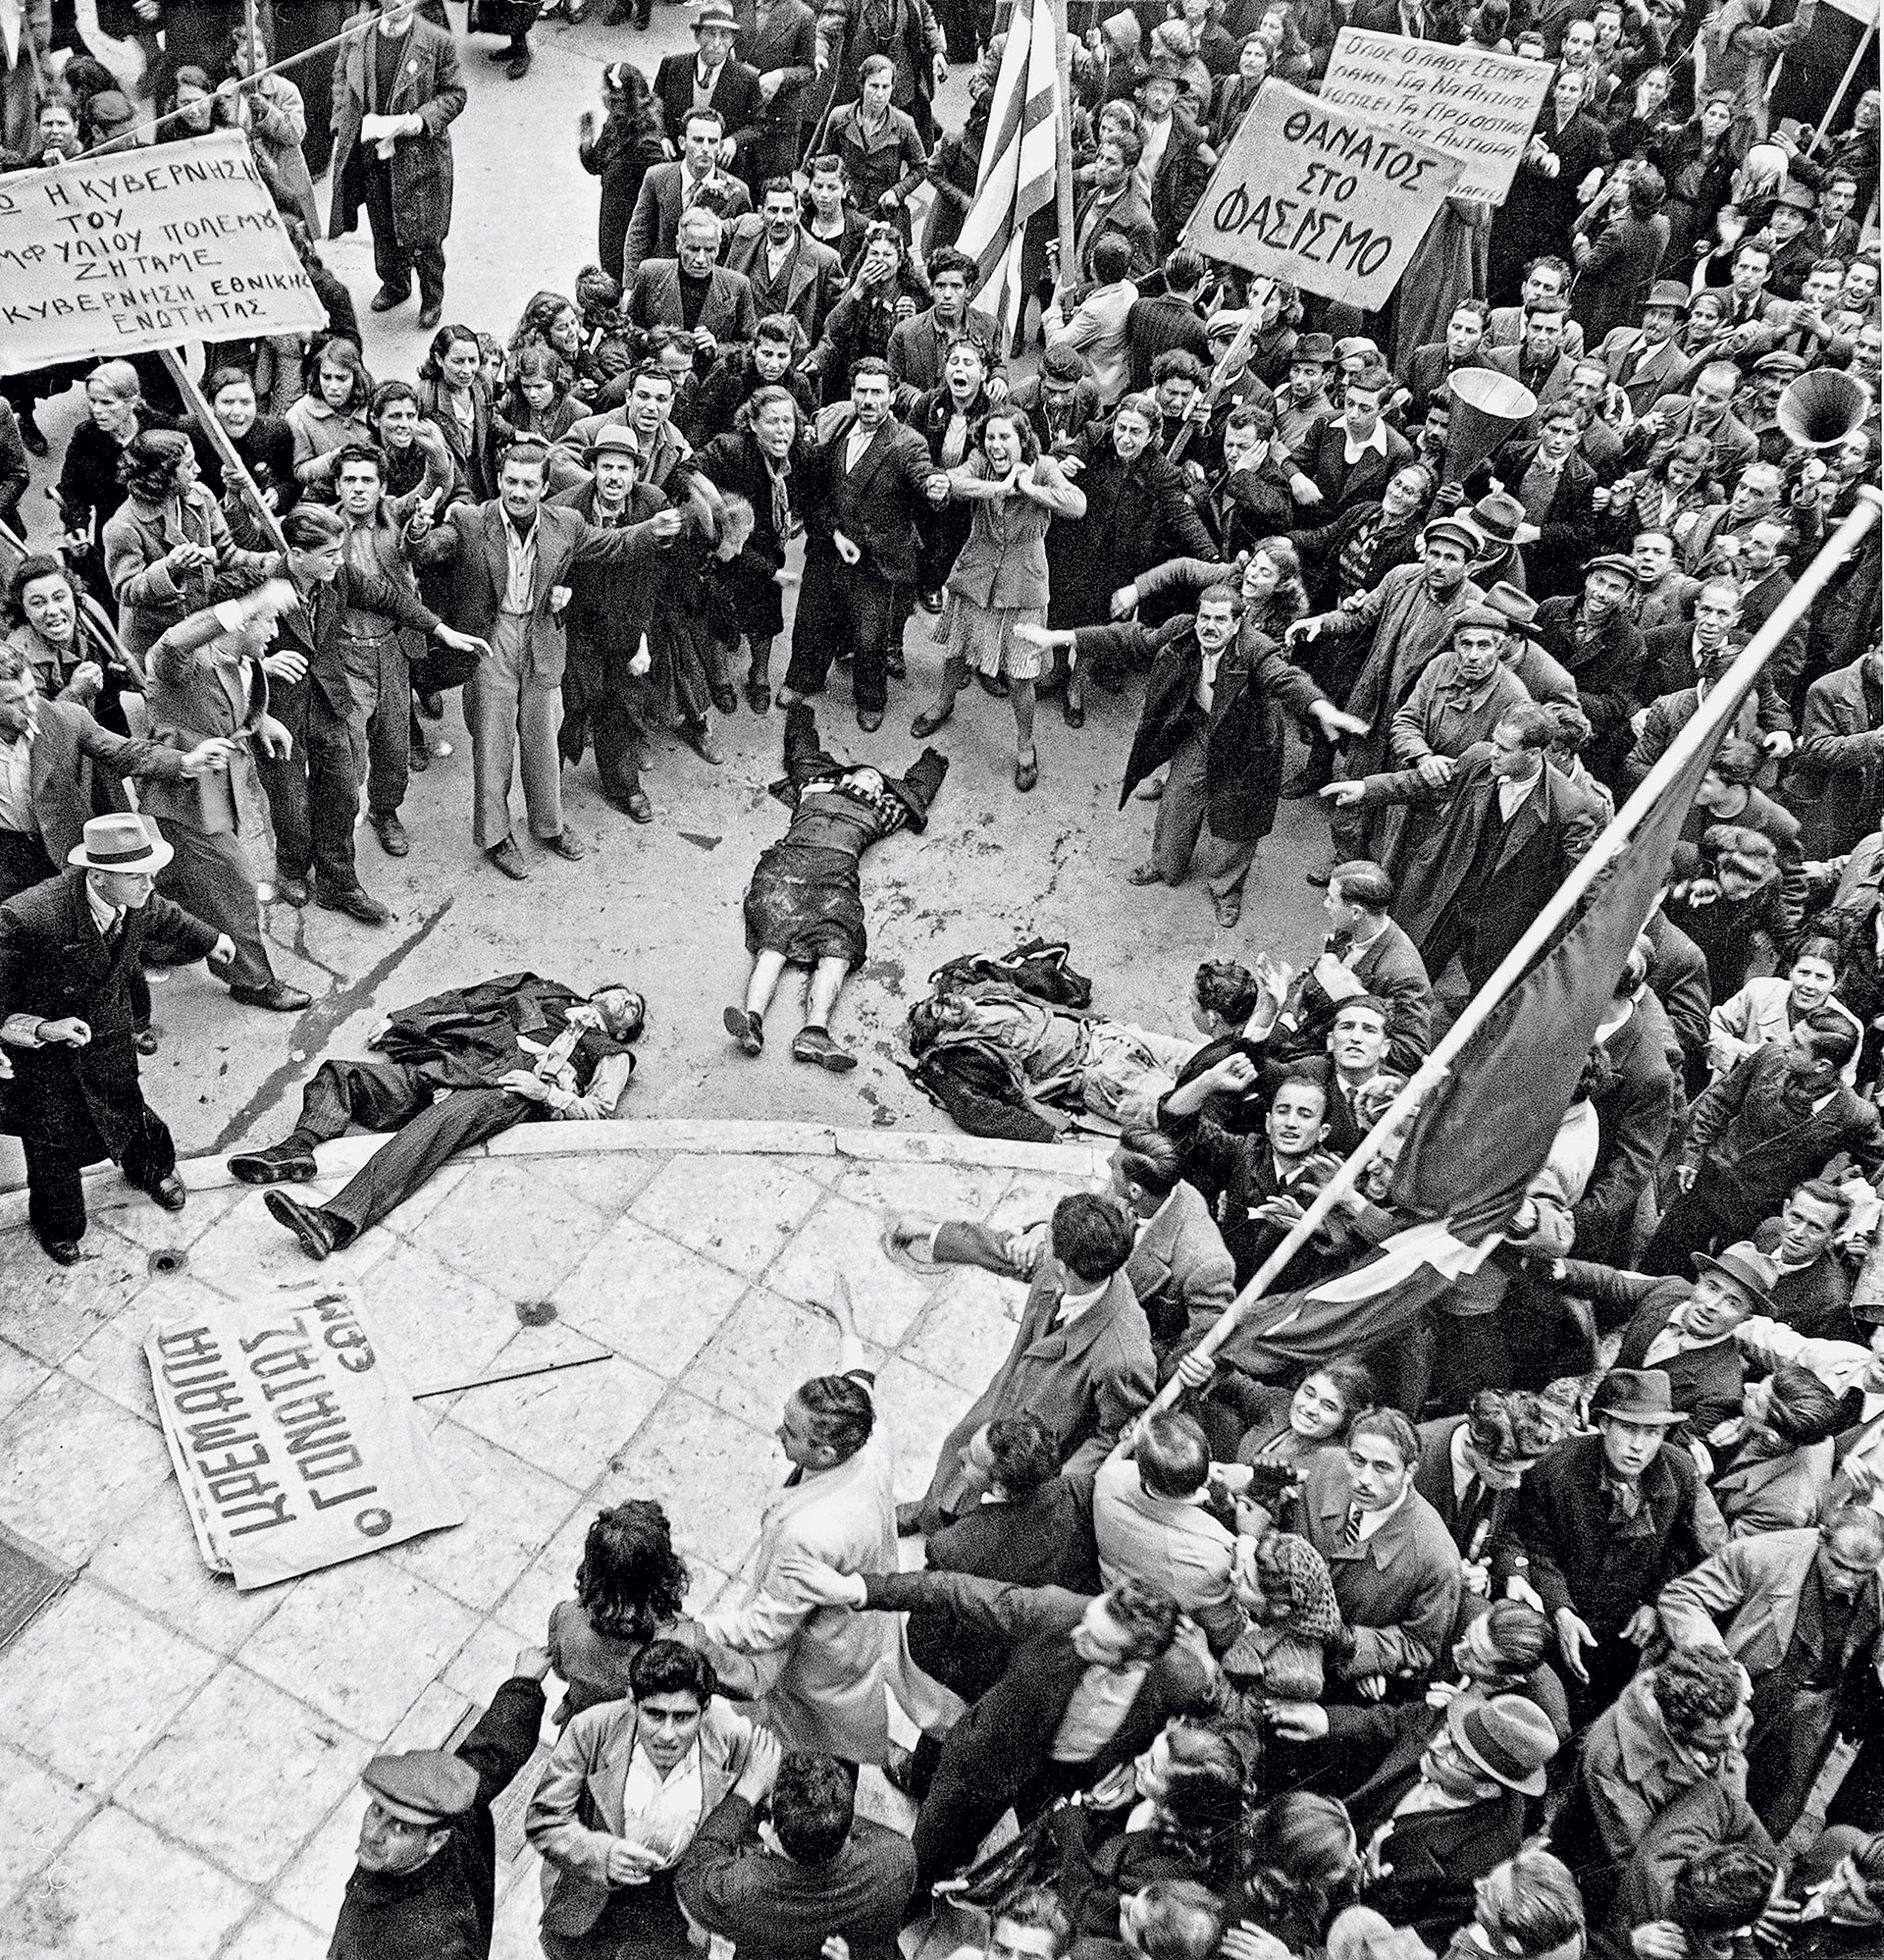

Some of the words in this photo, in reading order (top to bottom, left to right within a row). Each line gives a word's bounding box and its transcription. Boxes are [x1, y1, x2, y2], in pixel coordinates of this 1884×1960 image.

[1283, 110, 1438, 191] ΘΑΝΑΤΟΣ
[44, 184, 70, 206] Η
[78, 160, 261, 204] ΚΥΒΕΡΝΗΣΗ
[1297, 162, 1358, 202] ΣΤΟ
[56, 208, 124, 234] ΤΟΥ
[1213, 183, 1392, 277] ΦΑΣΙΣΜΟ
[75, 249, 223, 281] ΖΗΤΑΜΕ
[2, 285, 196, 325] ΚΥΒΕΡΝΗΣΗ
[210, 273, 311, 296] ΕΘΝΙΚΗΣ
[238, 1315, 379, 1511] ΓΟΝΑΤΑΣ
